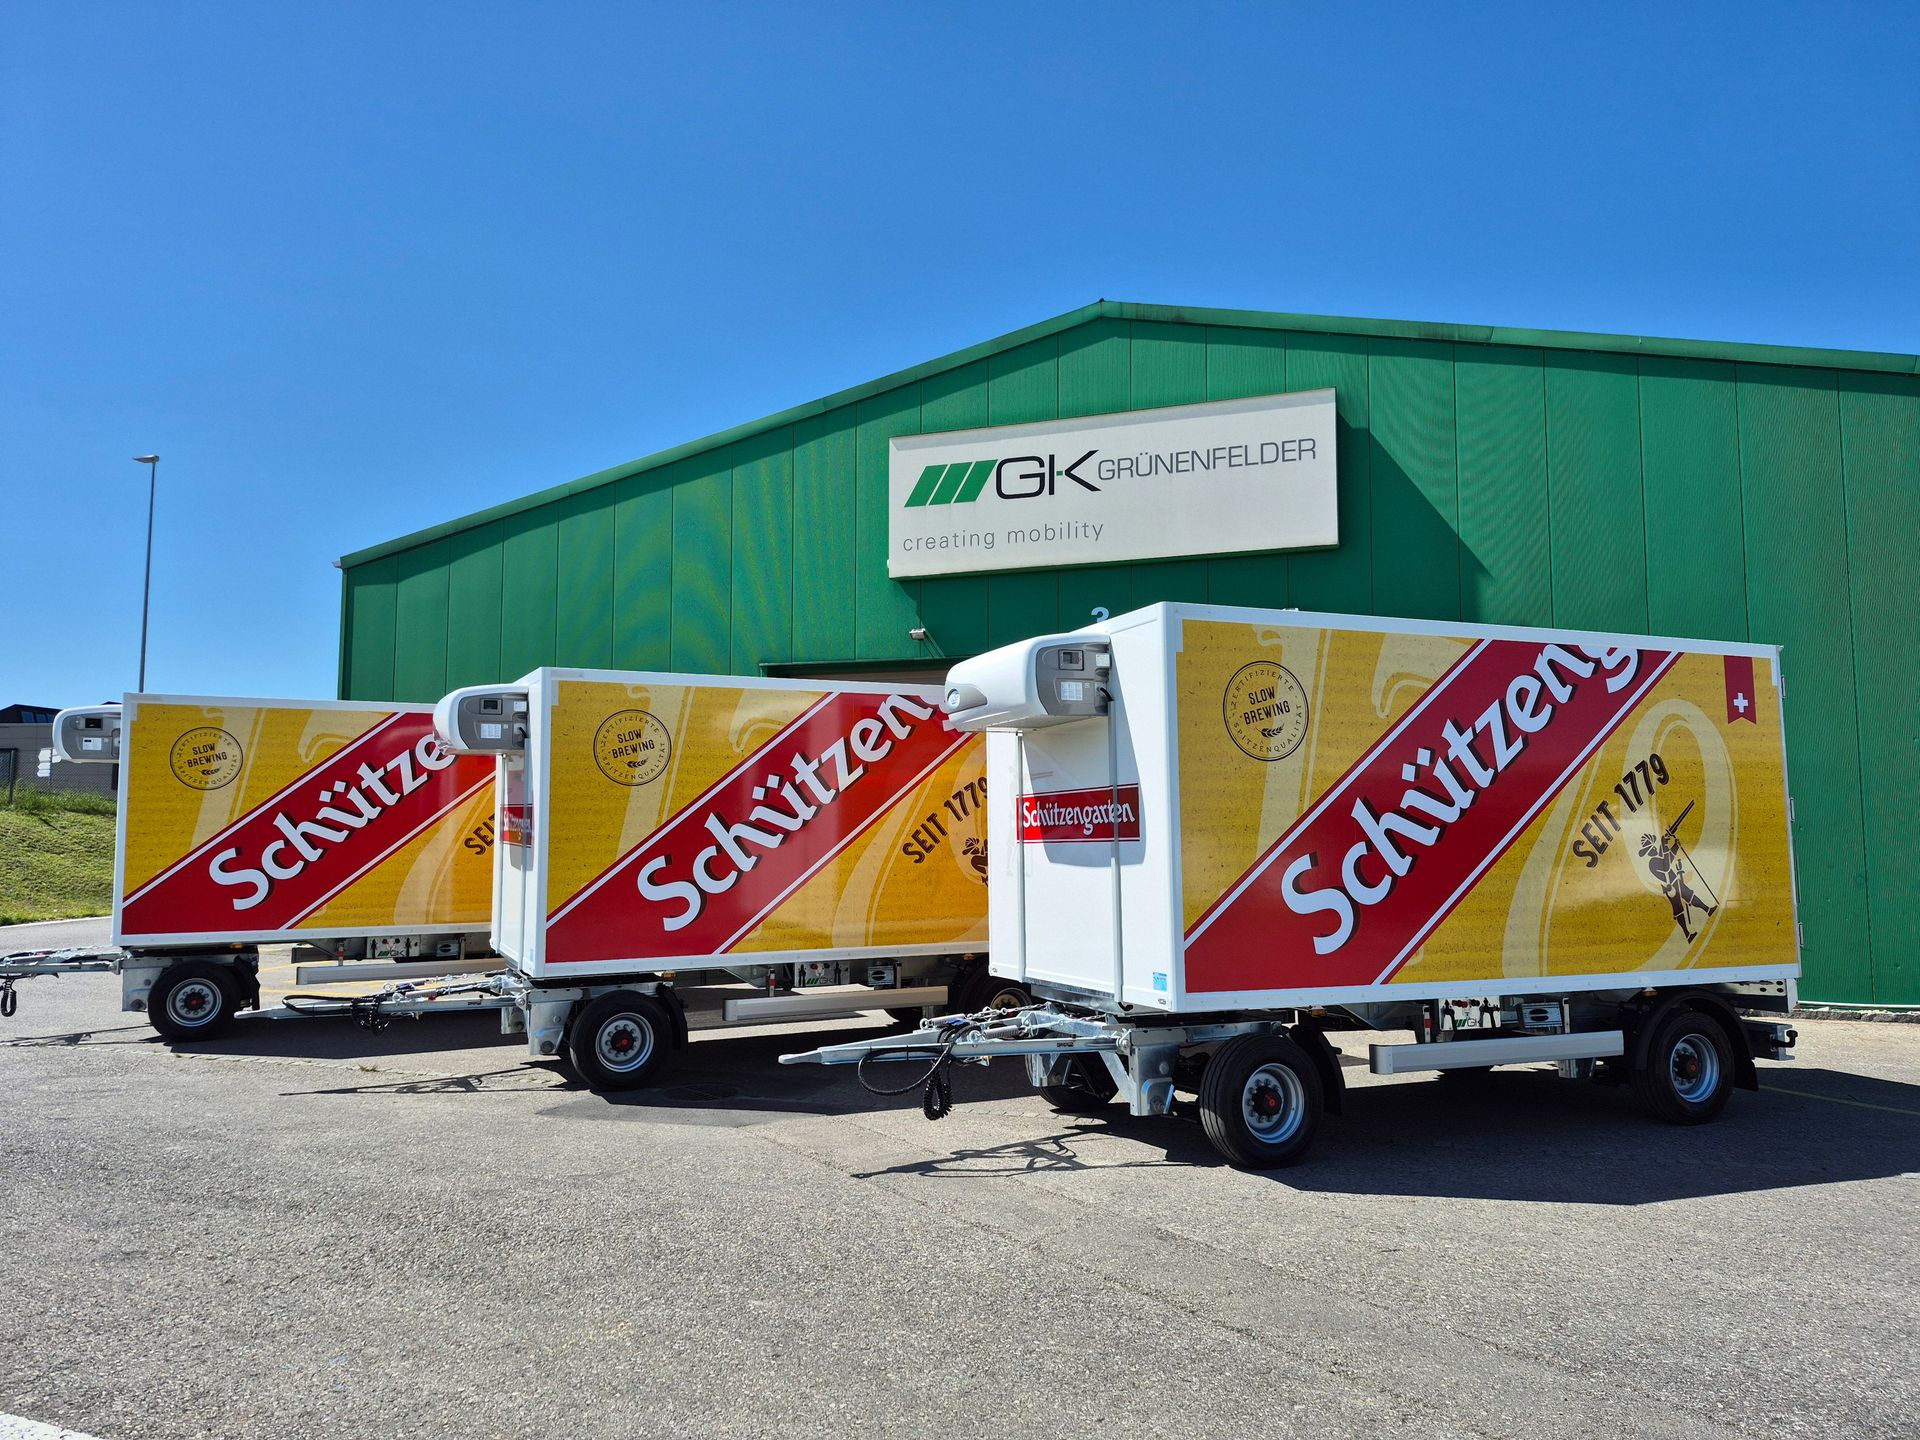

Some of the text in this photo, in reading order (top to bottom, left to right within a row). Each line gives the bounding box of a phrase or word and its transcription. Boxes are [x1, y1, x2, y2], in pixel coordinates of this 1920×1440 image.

[995, 437, 1317, 500] GK GRÜNENFELDER
[903, 520, 1104, 552] creating mobility
[1231, 669, 1295, 707] ZERTIFIZIERTE
[1248, 686, 1275, 705] SLOW
[1243, 700, 1291, 725] BREWING
[192, 743, 215, 755] SLOW
[611, 739, 655, 759] BREWING
[617, 728, 642, 744] SLOW
[187, 751, 228, 768] BREWING
[1023, 799, 1136, 836] Schützengarten
[1280, 644, 1638, 956] Schützeng
[1572, 753, 1670, 868] SEIT 1779
[208, 733, 456, 911] Schütze
[464, 813, 495, 856] SEI
[902, 812, 948, 864] SEIT
